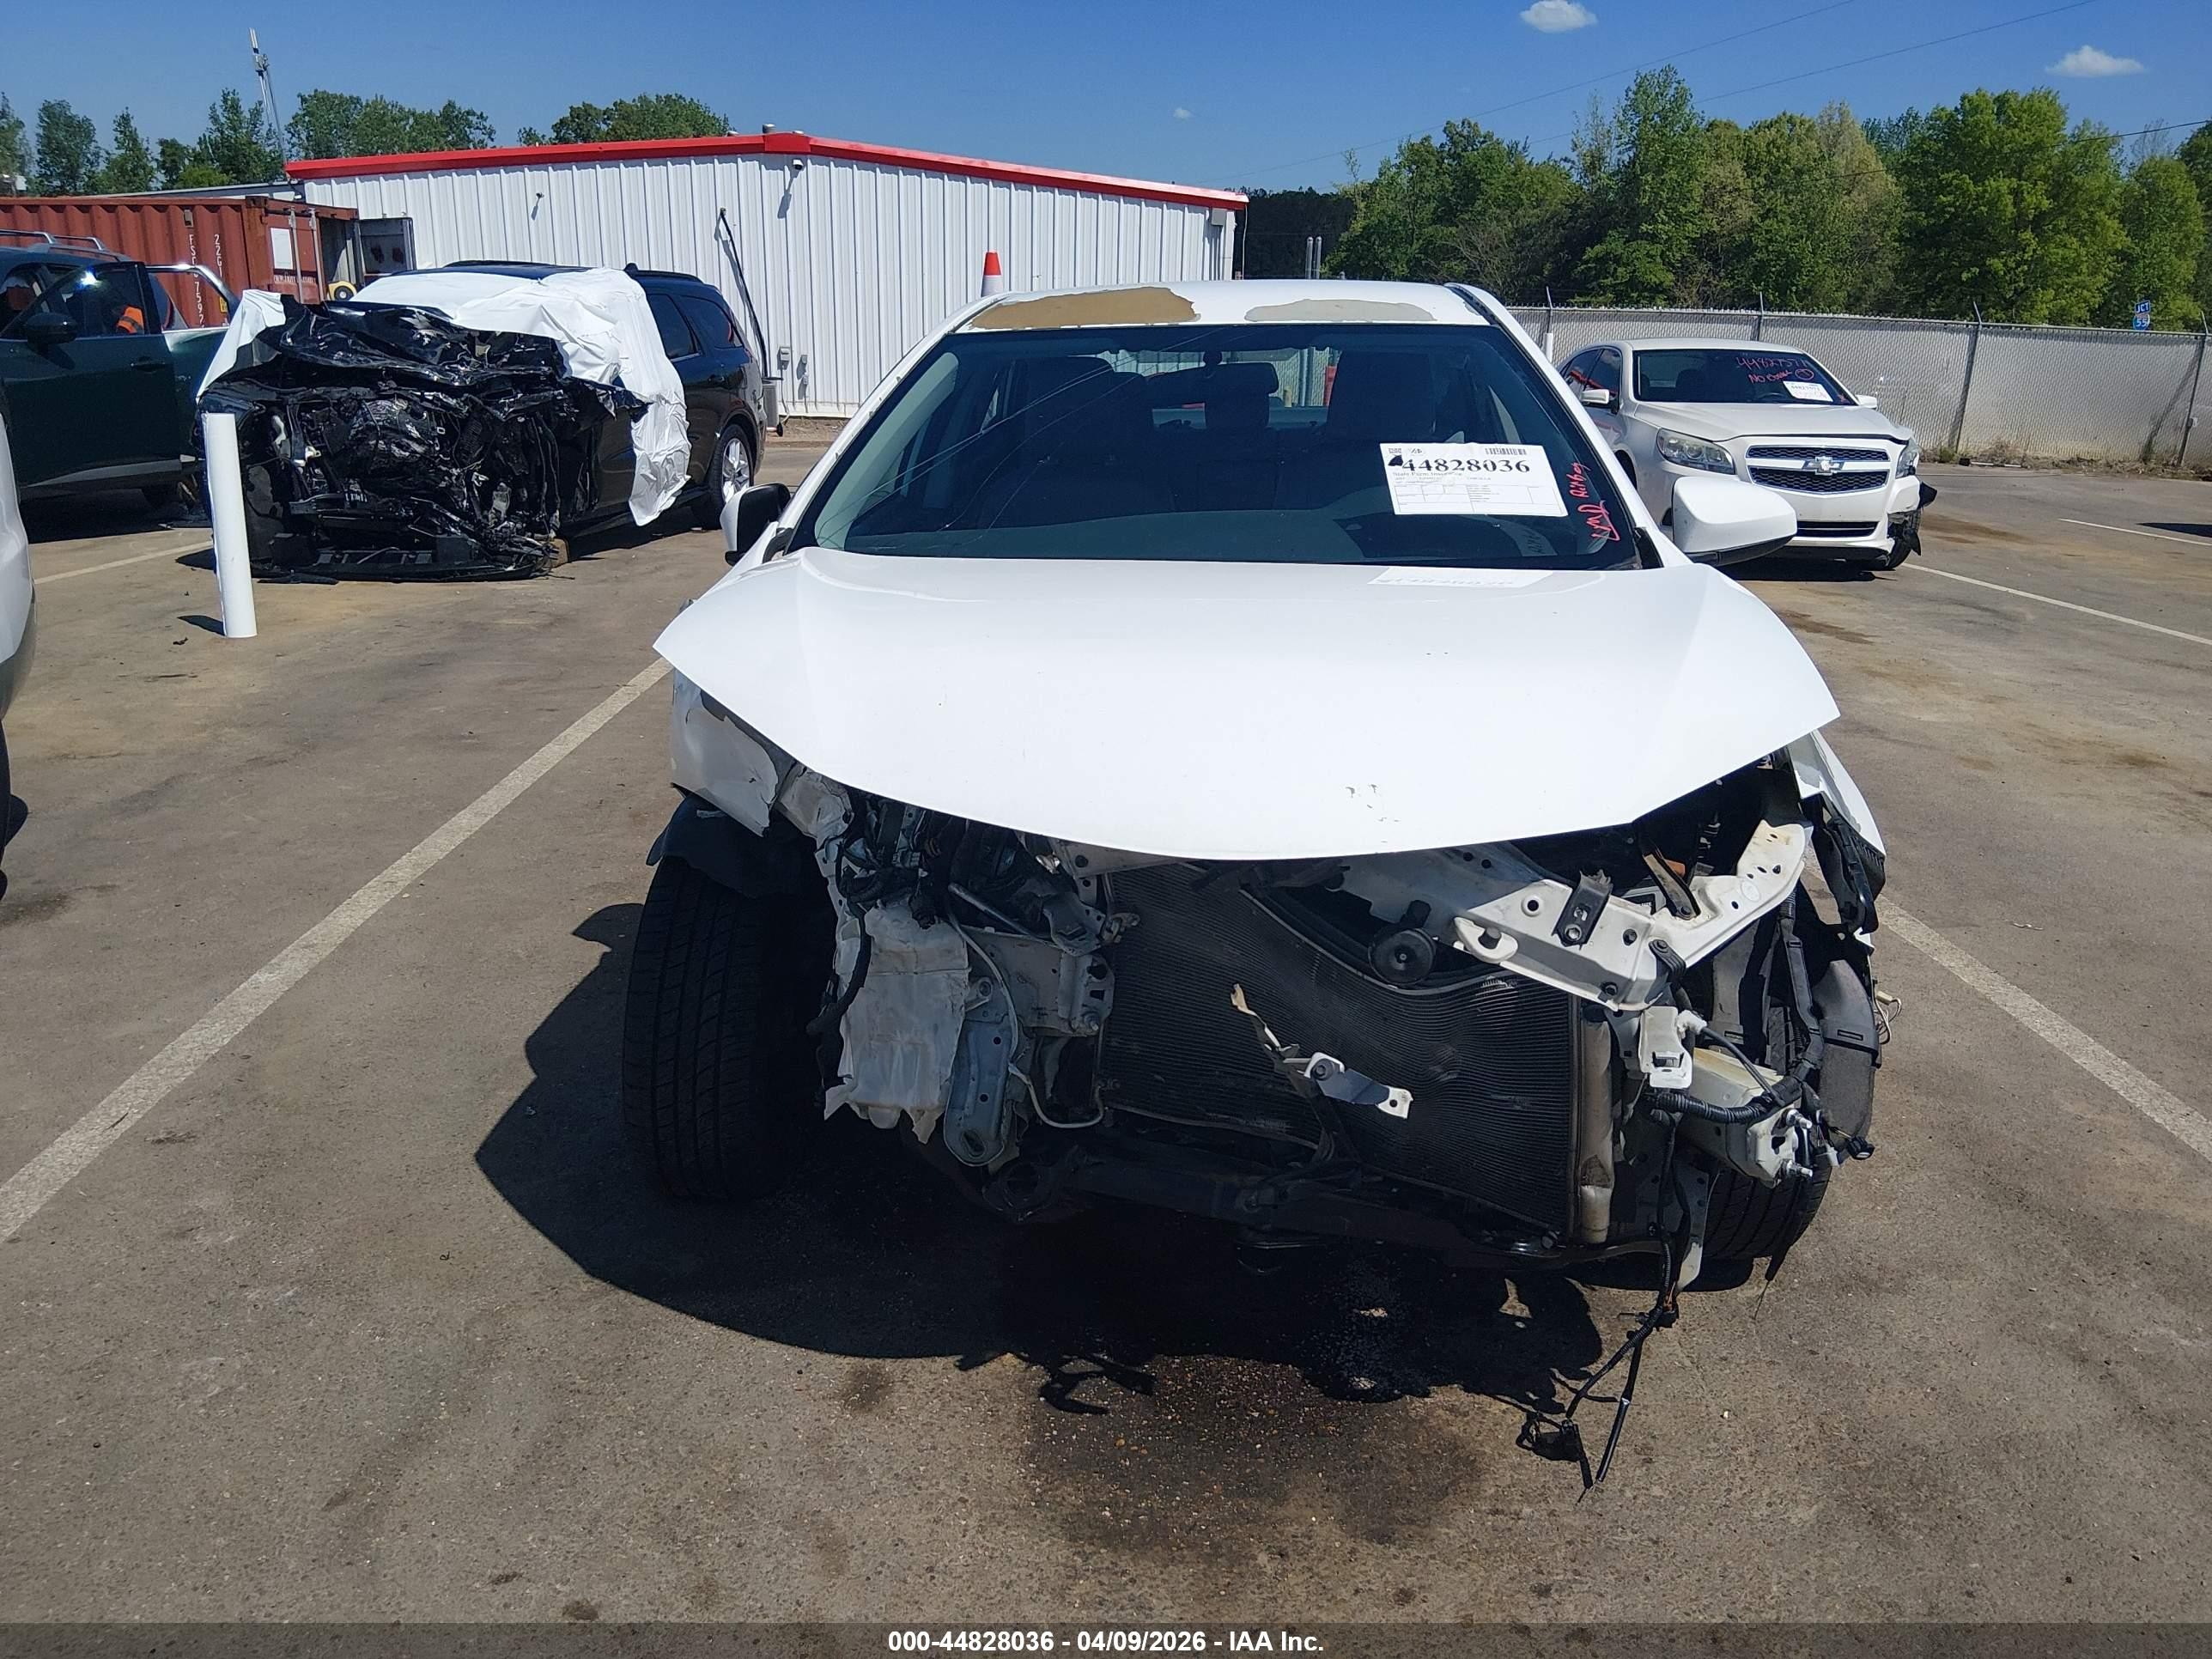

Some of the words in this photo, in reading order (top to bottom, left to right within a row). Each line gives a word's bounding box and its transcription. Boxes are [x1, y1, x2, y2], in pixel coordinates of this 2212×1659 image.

[214, 234, 223, 278] 22G1
[2136, 302, 2149, 313] JCT
[2136, 318, 2148, 327] 55
[1402, 459, 1531, 473] 44828036
